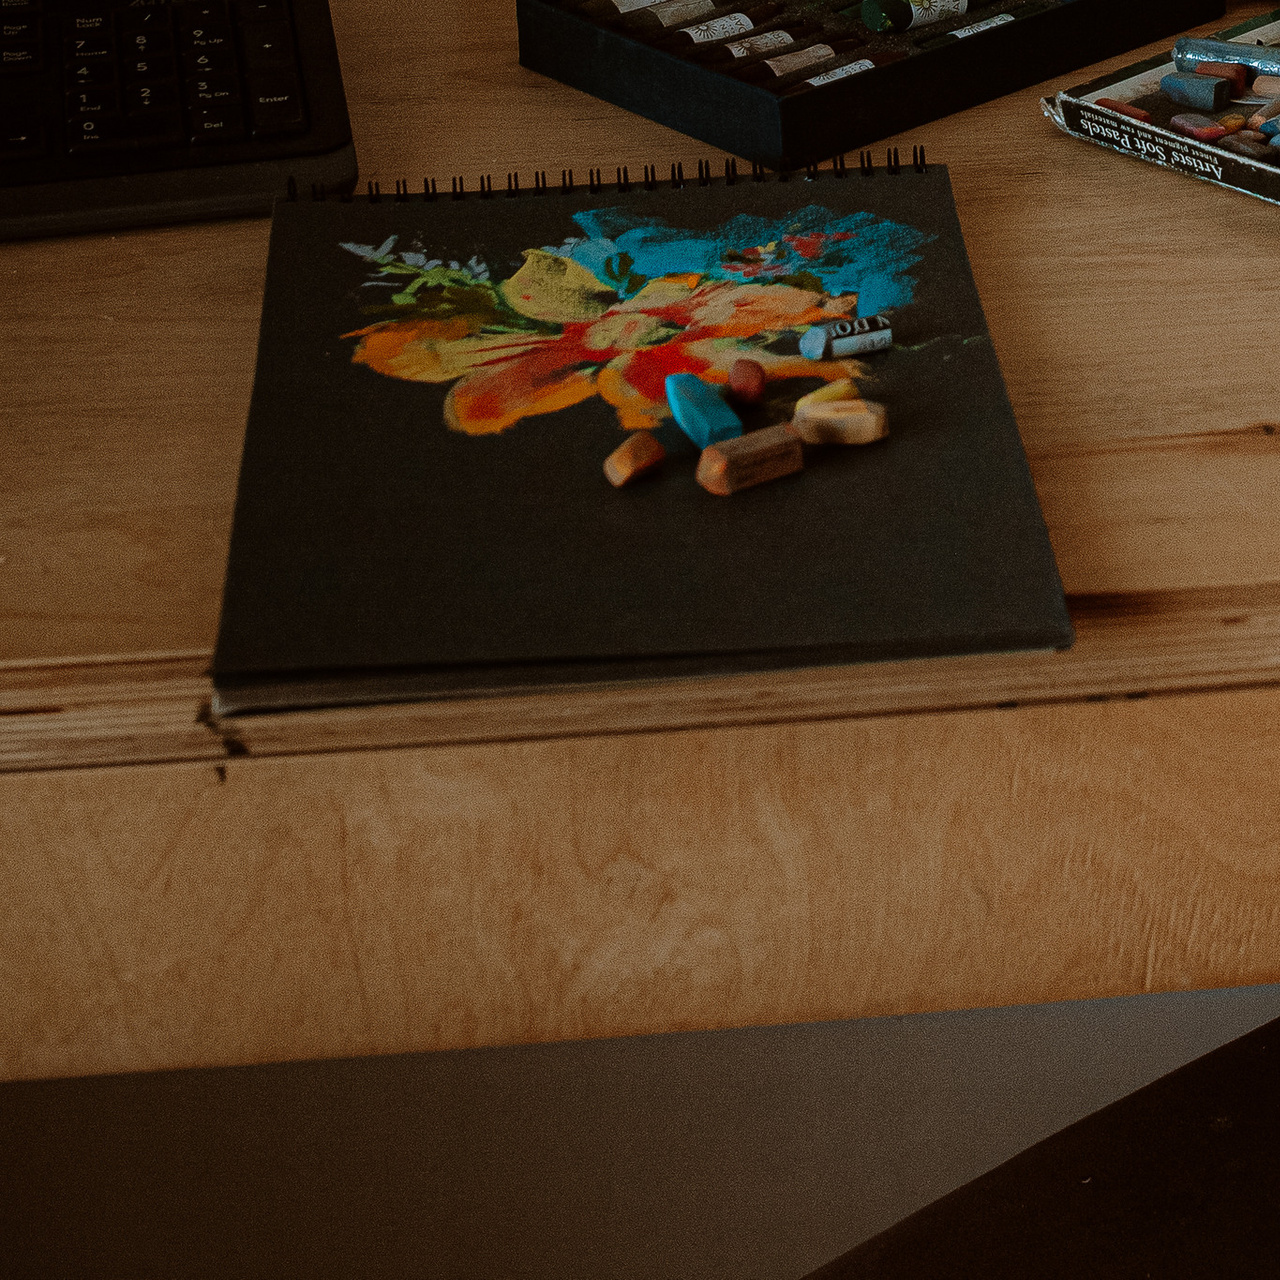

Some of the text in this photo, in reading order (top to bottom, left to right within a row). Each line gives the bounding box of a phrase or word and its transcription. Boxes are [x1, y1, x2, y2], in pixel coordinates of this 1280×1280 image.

[192, 29, 203, 38] 9
[135, 35, 147, 44] 8
[75, 40, 85, 49] 7
[197, 55, 209, 64] 6
[77, 66, 89, 75] 4
[136, 62, 148, 72] 5
[198, 81, 208, 90] 3
[140, 88, 151, 97] 2
[79, 94, 87, 103] 1
[258, 95, 289, 103] Enter
[80, 104, 101, 112] End
[203, 121, 223, 129] Del
[1079, 109, 1219, 166] Finest pigment and raw materials
[1080, 118, 1223, 180] Artists' Soft Pastels
